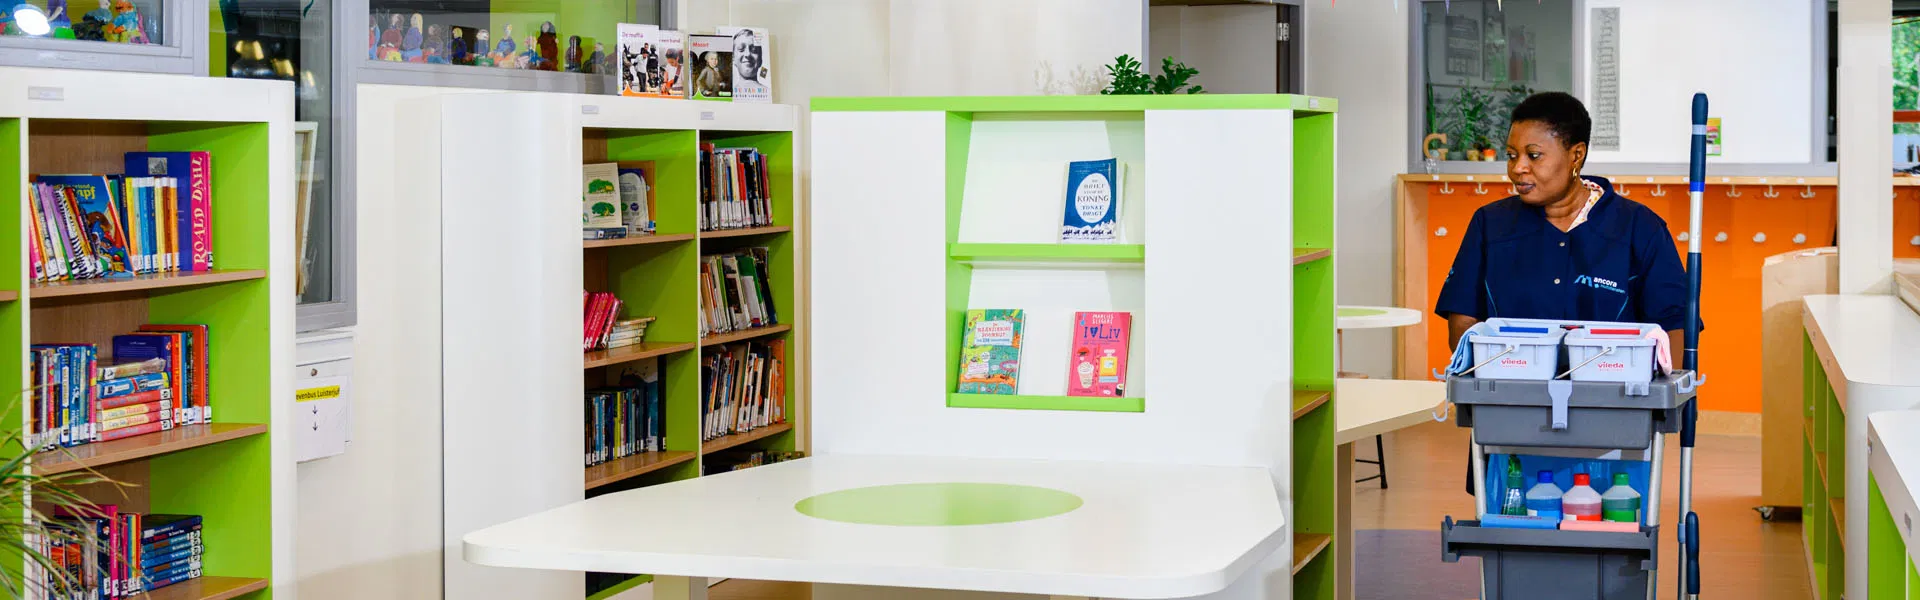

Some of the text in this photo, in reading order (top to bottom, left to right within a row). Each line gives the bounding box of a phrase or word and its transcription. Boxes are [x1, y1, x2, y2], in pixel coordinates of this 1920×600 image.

[1077, 195, 1109, 203] KONING
[192, 156, 207, 264] ROALD DAHL
[1593, 276, 1618, 288] ancora
[1501, 357, 1527, 365] vileda
[1597, 361, 1624, 369] vileda
